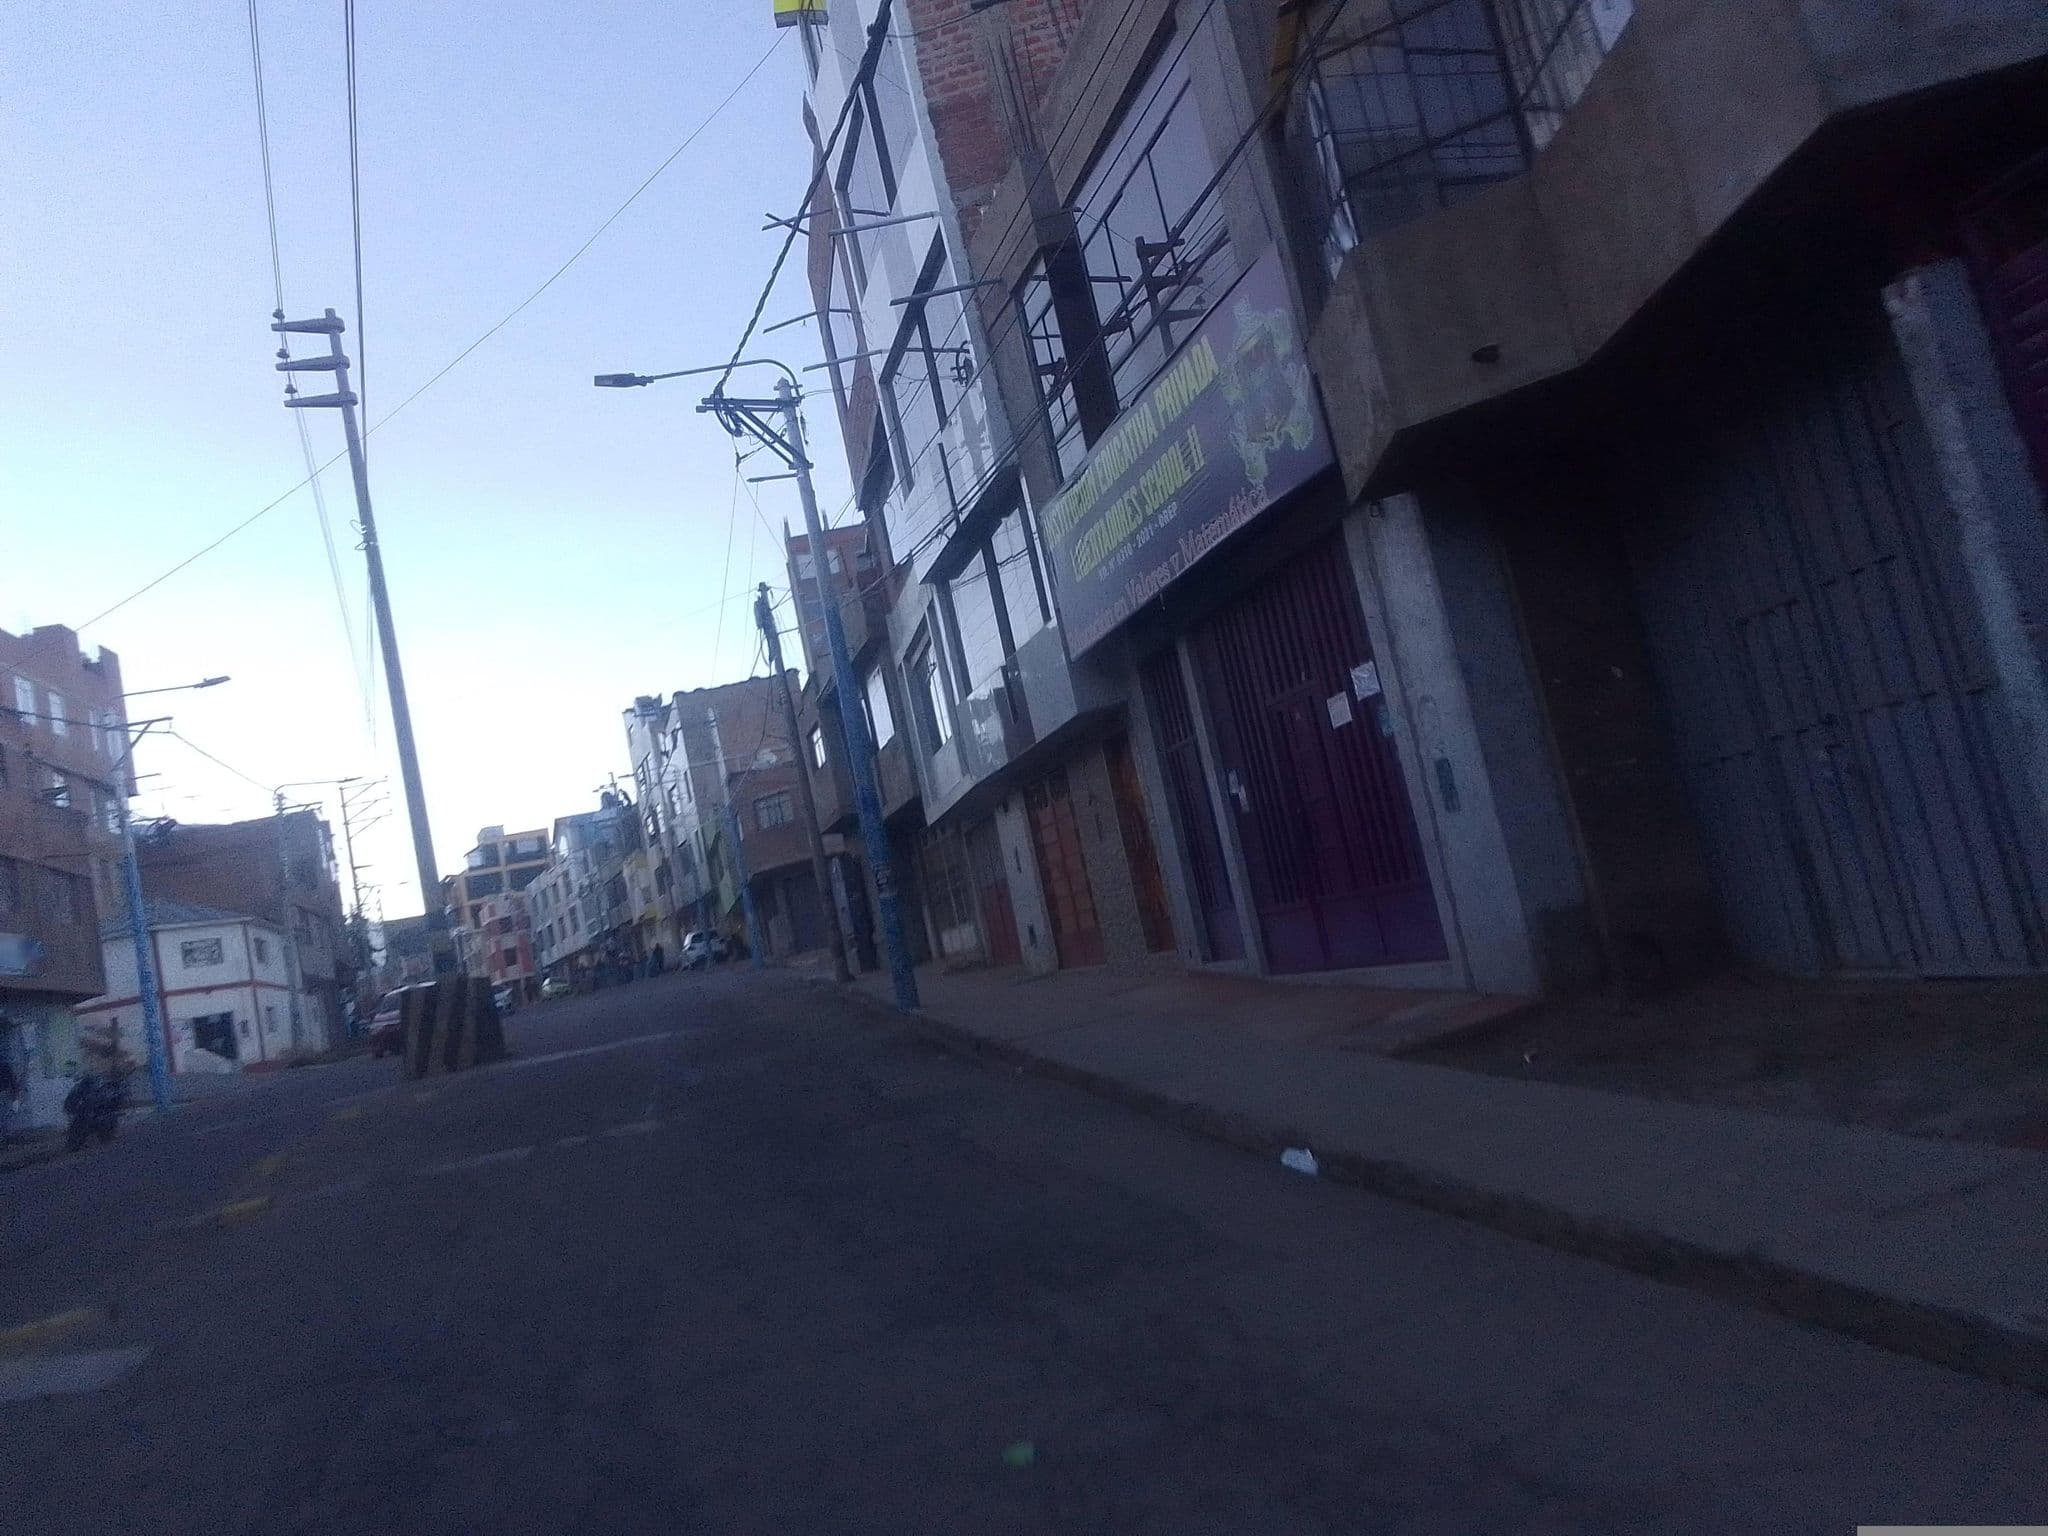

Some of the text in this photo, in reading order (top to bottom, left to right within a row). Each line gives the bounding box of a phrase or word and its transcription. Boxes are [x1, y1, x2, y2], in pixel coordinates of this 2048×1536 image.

[1095, 402, 1158, 491] EDUCATIVA
[1154, 334, 1219, 430] PRIVADA
[1139, 441, 1192, 517] SCHOOL
[1125, 556, 1171, 611] Valores
